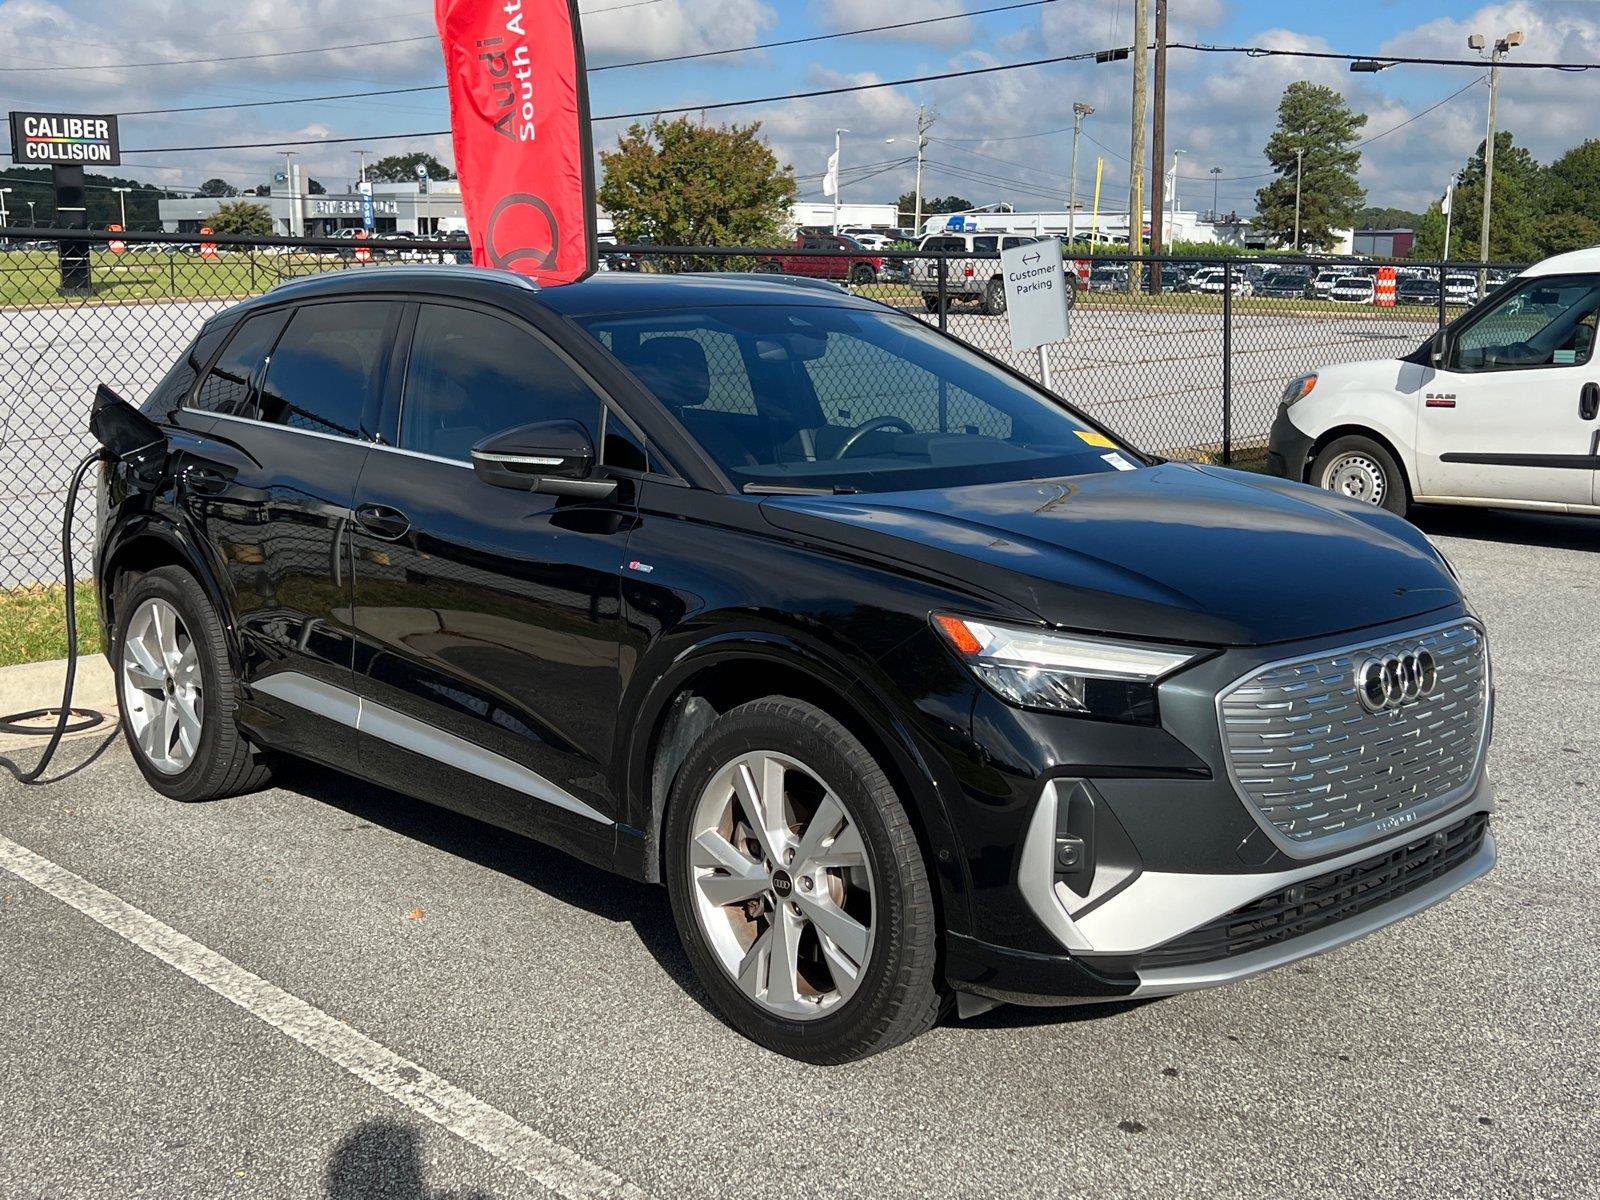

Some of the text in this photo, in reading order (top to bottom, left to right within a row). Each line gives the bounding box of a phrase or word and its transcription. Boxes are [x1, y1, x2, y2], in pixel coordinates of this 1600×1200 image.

[476, 37, 517, 142] Audi
[511, 45, 536, 142] South
[24, 116, 109, 139] CALIBER
[26, 142, 111, 160] COLLISION
[1009, 264, 1056, 282] Customer
[1016, 280, 1052, 295] Parking
